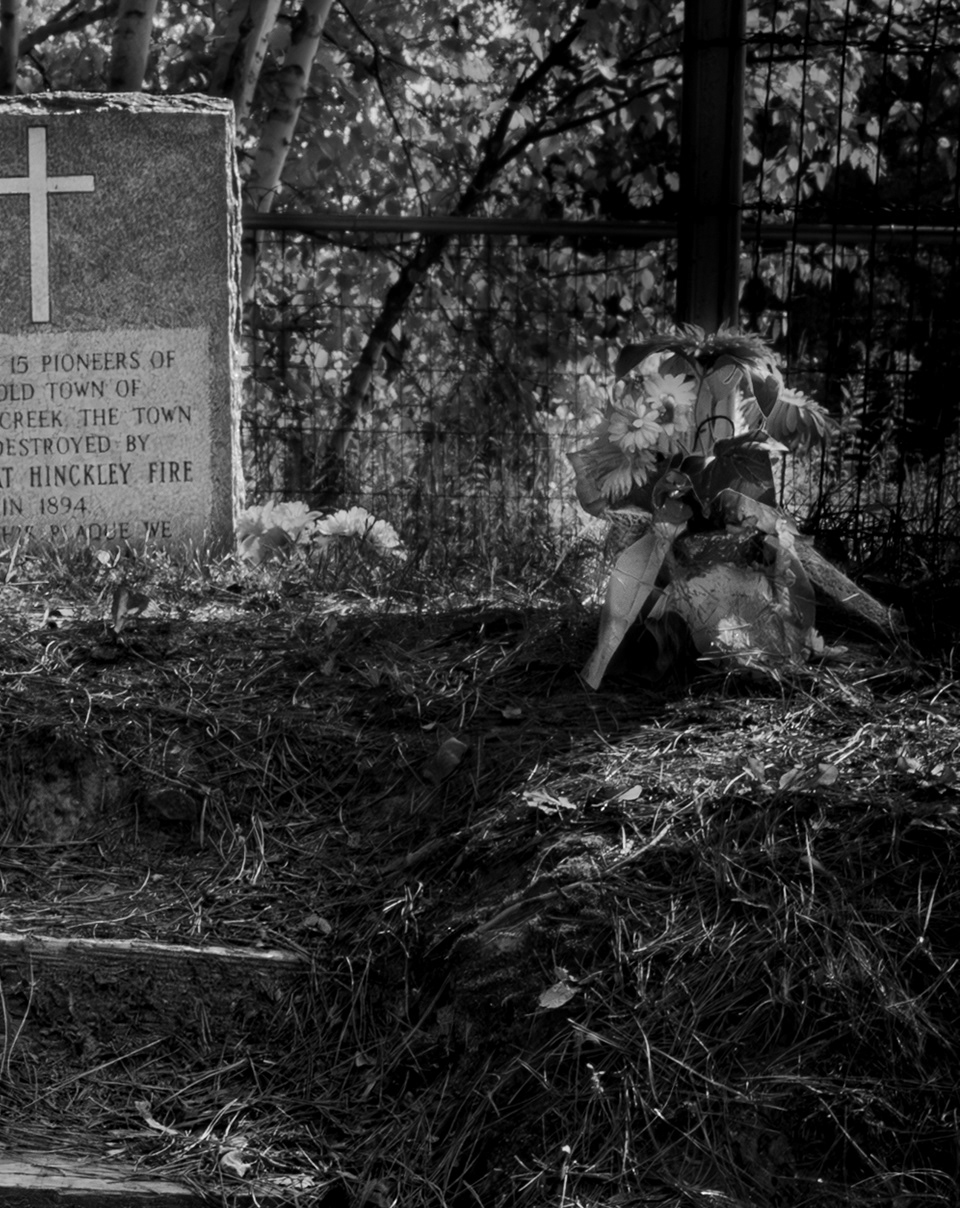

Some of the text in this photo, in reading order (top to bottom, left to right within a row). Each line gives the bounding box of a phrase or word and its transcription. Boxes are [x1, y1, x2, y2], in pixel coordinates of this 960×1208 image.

[10, 356, 28, 374] 15
[41, 351, 140, 373] PIONEERS
[150, 350, 176, 369] OF
[46, 381, 105, 399] TOWN
[116, 379, 142, 397] OF
[0, 410, 62, 428] CREEK
[79, 408, 119, 426] THE
[133, 405, 192, 424] TOWN
[126, 435, 150, 452] BY
[30, 463, 131, 487] HINCKLEY
[149, 461, 193, 483] FIRE
[3, 496, 87, 516] IN 1894
[144, 520, 172, 538] WE
